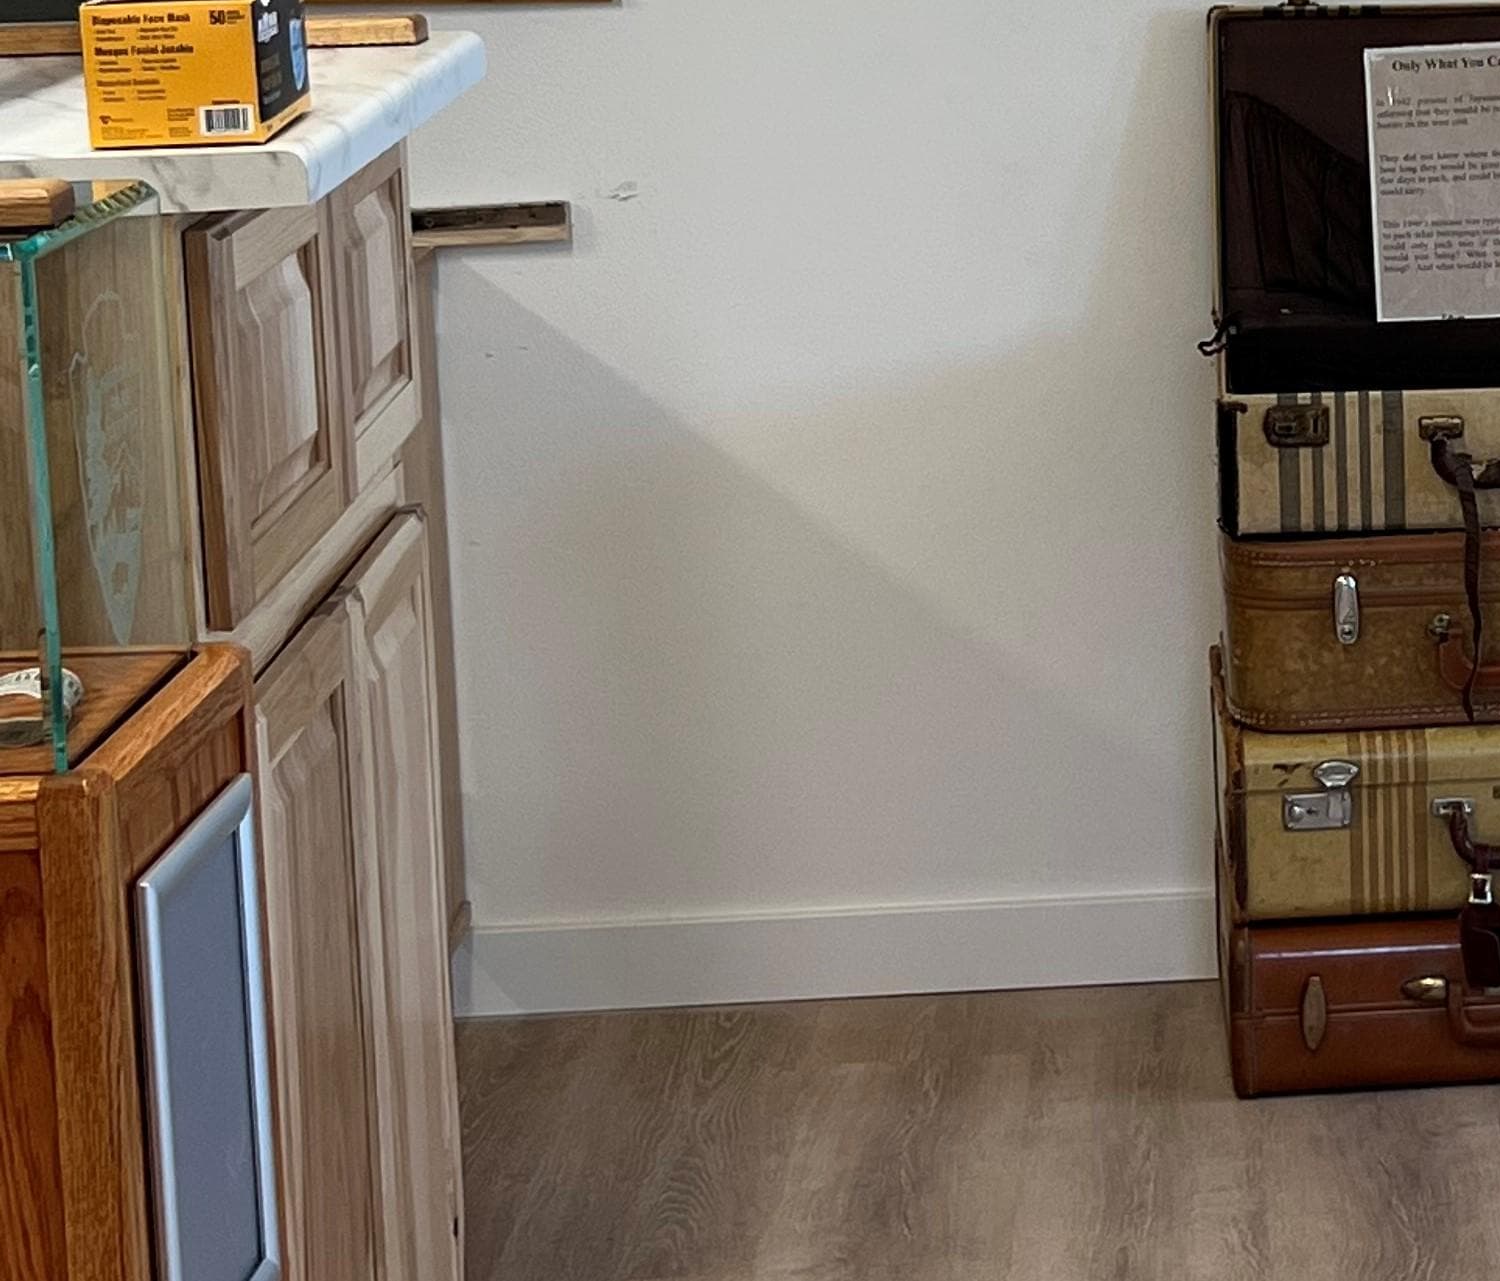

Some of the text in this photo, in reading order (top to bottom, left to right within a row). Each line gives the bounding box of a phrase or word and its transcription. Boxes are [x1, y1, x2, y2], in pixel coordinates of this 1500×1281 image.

[92, 12, 190, 26] Disposable Face Mask
[208, 10, 225, 25] 50
[1392, 59, 1421, 74] Only
[1425, 57, 1456, 70] What
[1461, 56, 1485, 69] You
